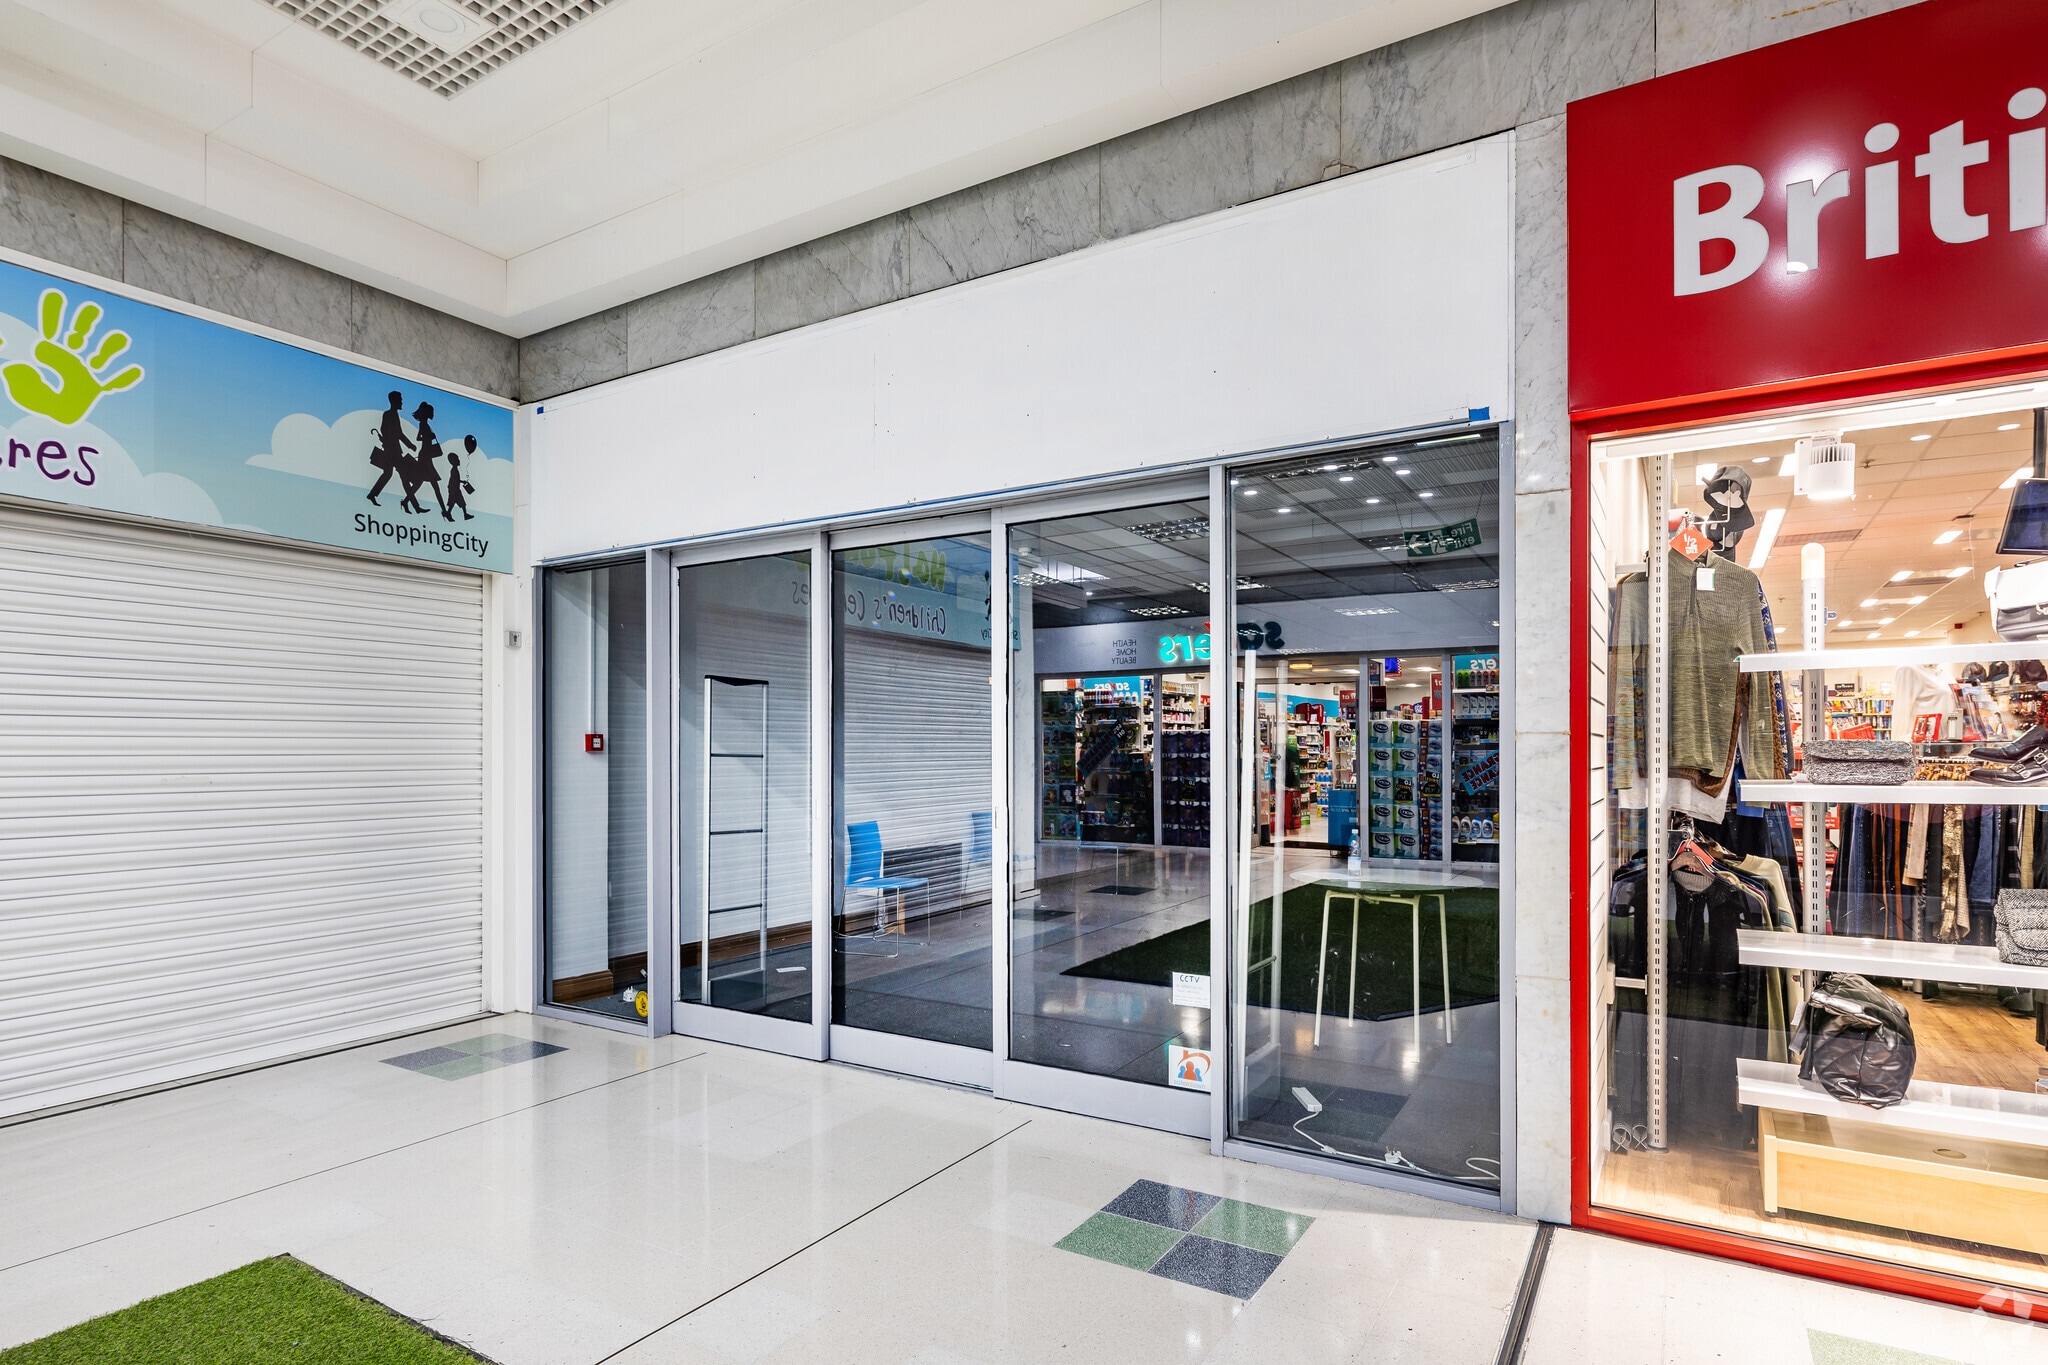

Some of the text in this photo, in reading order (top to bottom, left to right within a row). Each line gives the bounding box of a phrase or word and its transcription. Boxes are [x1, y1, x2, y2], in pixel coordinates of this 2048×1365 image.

[1674, 87, 2048, 296] Briti
[0, 438, 99, 485] res
[354, 513, 489, 557] ShoppingCity
[1179, 974, 1200, 983] CCTV
